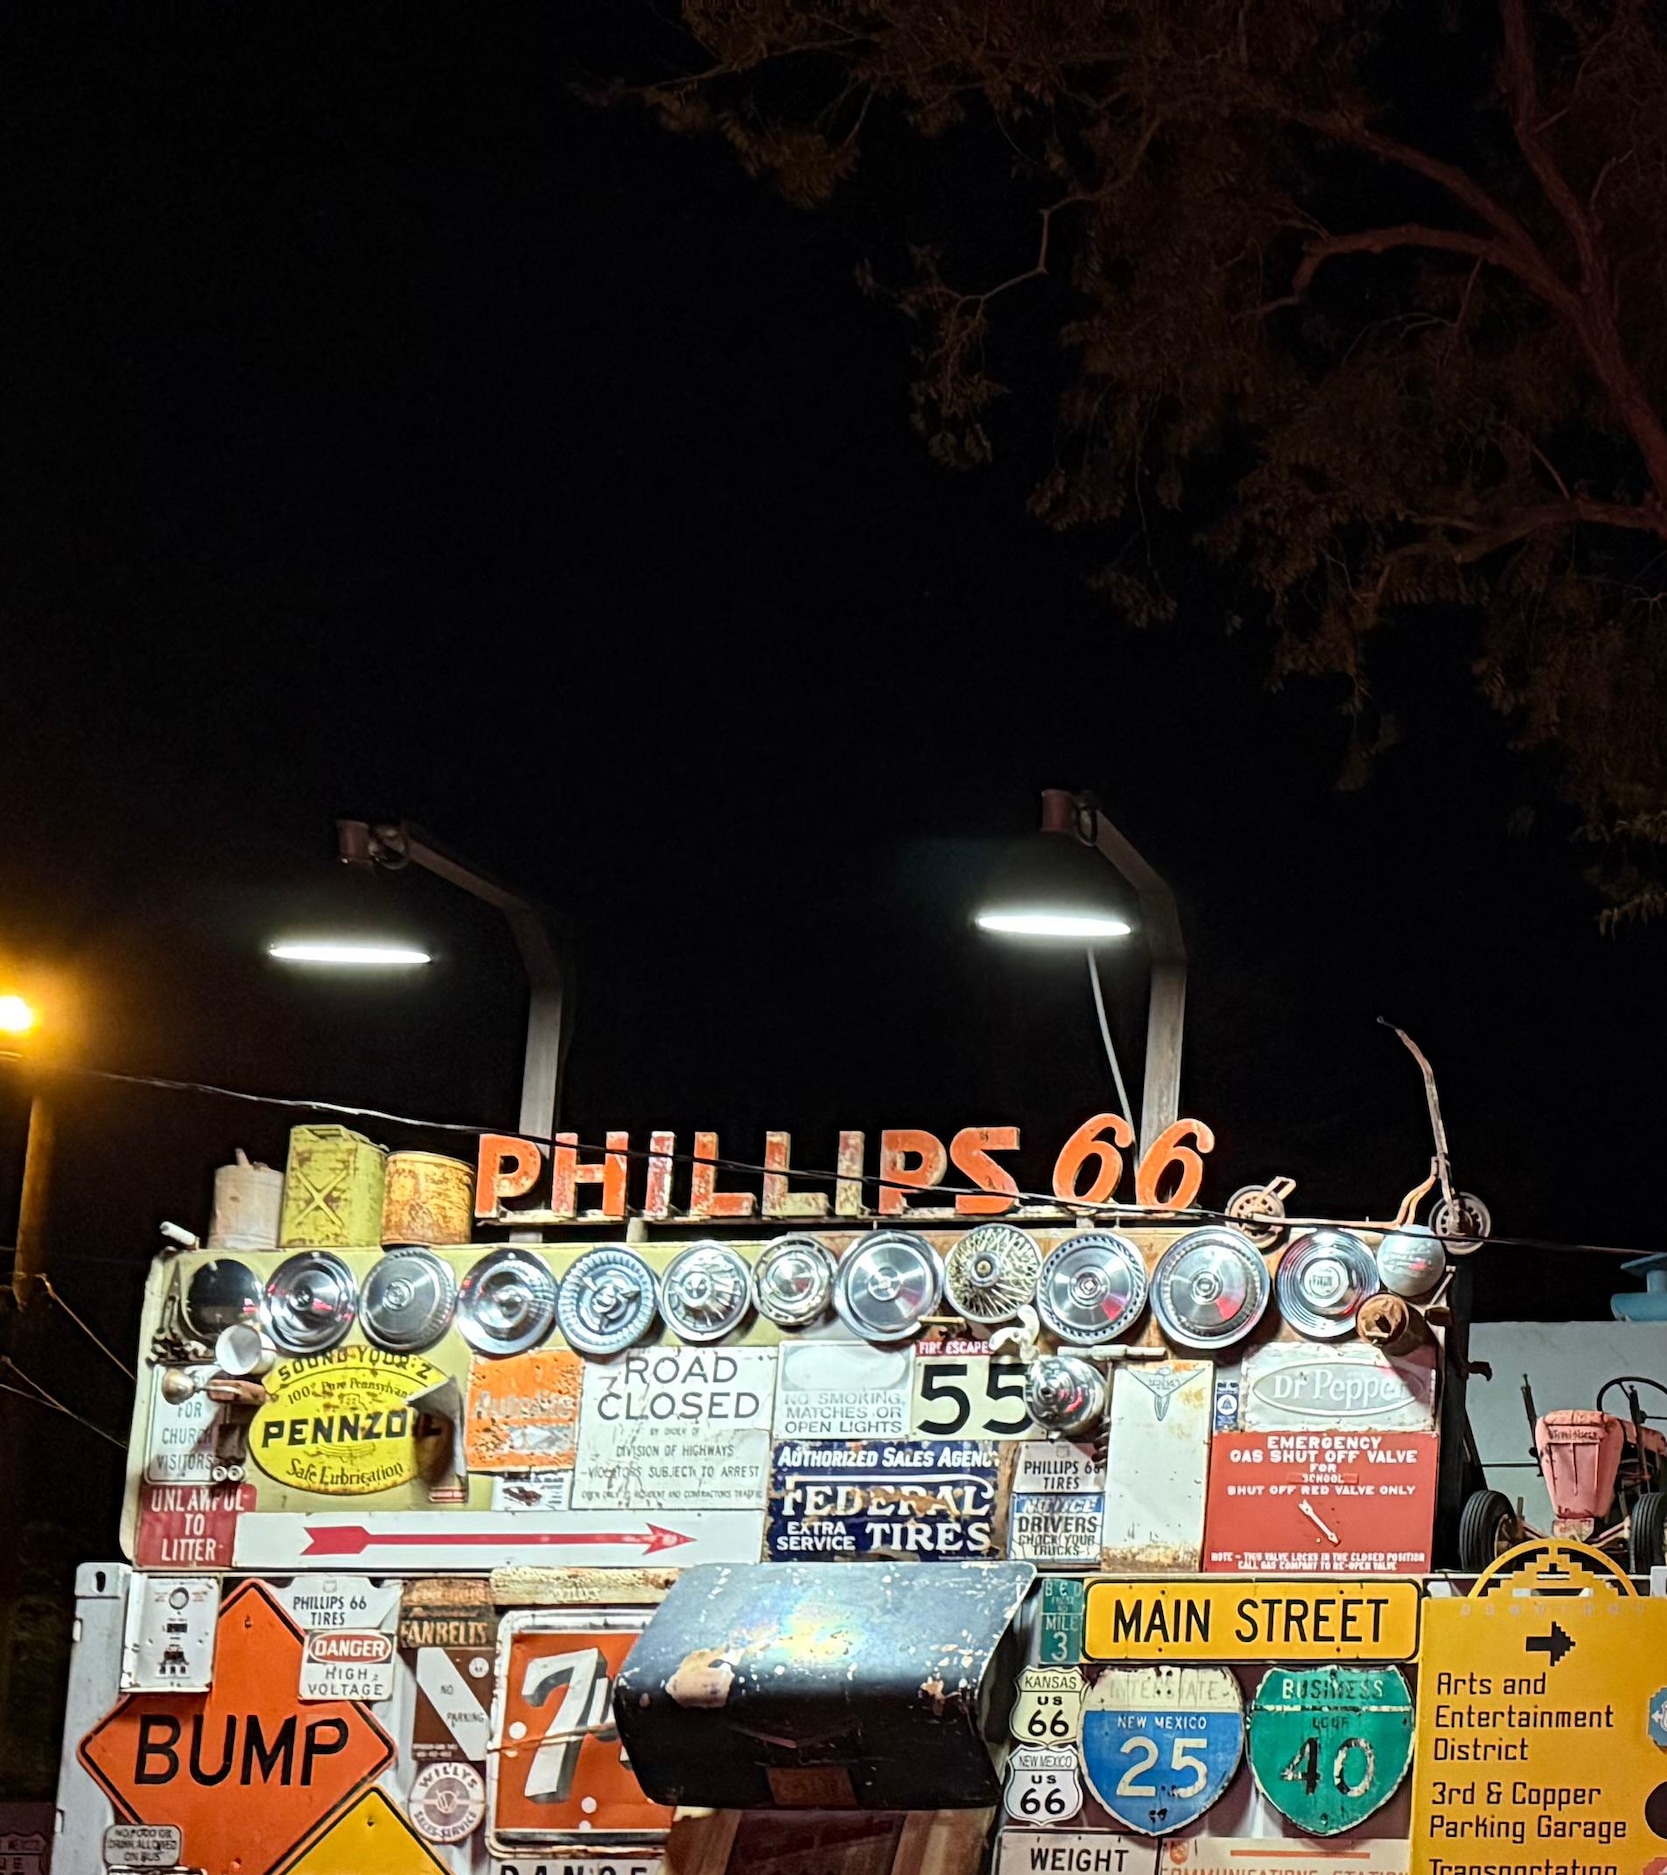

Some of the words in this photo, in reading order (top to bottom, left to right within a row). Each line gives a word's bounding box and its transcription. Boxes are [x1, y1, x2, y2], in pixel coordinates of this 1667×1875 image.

[475, 1126, 1020, 1218] PHILLIPS
[1053, 1112, 1214, 1211] 66
[624, 1356, 738, 1385] ROAD
[597, 1392, 760, 1421] CLOSED
[1267, 1436, 1382, 1450] EMERGENCY
[1230, 1450, 1263, 1463] GAS
[1270, 1450, 1318, 1464] SHUT
[1325, 1450, 1357, 1463] OFF
[1367, 1450, 1418, 1464] VALVE
[1112, 1599, 1211, 1643] MAIN
[1235, 1598, 1389, 1643] STREET
[313, 1640, 388, 1658] DANGER
[324, 1668, 368, 1681] HIGH
[1437, 1671, 1492, 1695] Arts
[1503, 1672, 1546, 1695] and
[308, 1683, 384, 1697] VOLTAGE
[1435, 1705, 1614, 1729] Entertainment
[134, 1714, 349, 1787] BUMP
[1434, 1738, 1528, 1761] District
[1115, 1737, 1208, 1798] 25
[1432, 1782, 1474, 1805] 3rd
[1486, 1782, 1502, 1805] &
[1512, 1782, 1601, 1811] Copper
[1430, 1815, 1525, 1844] Parking
[1537, 1816, 1627, 1844] Garage
